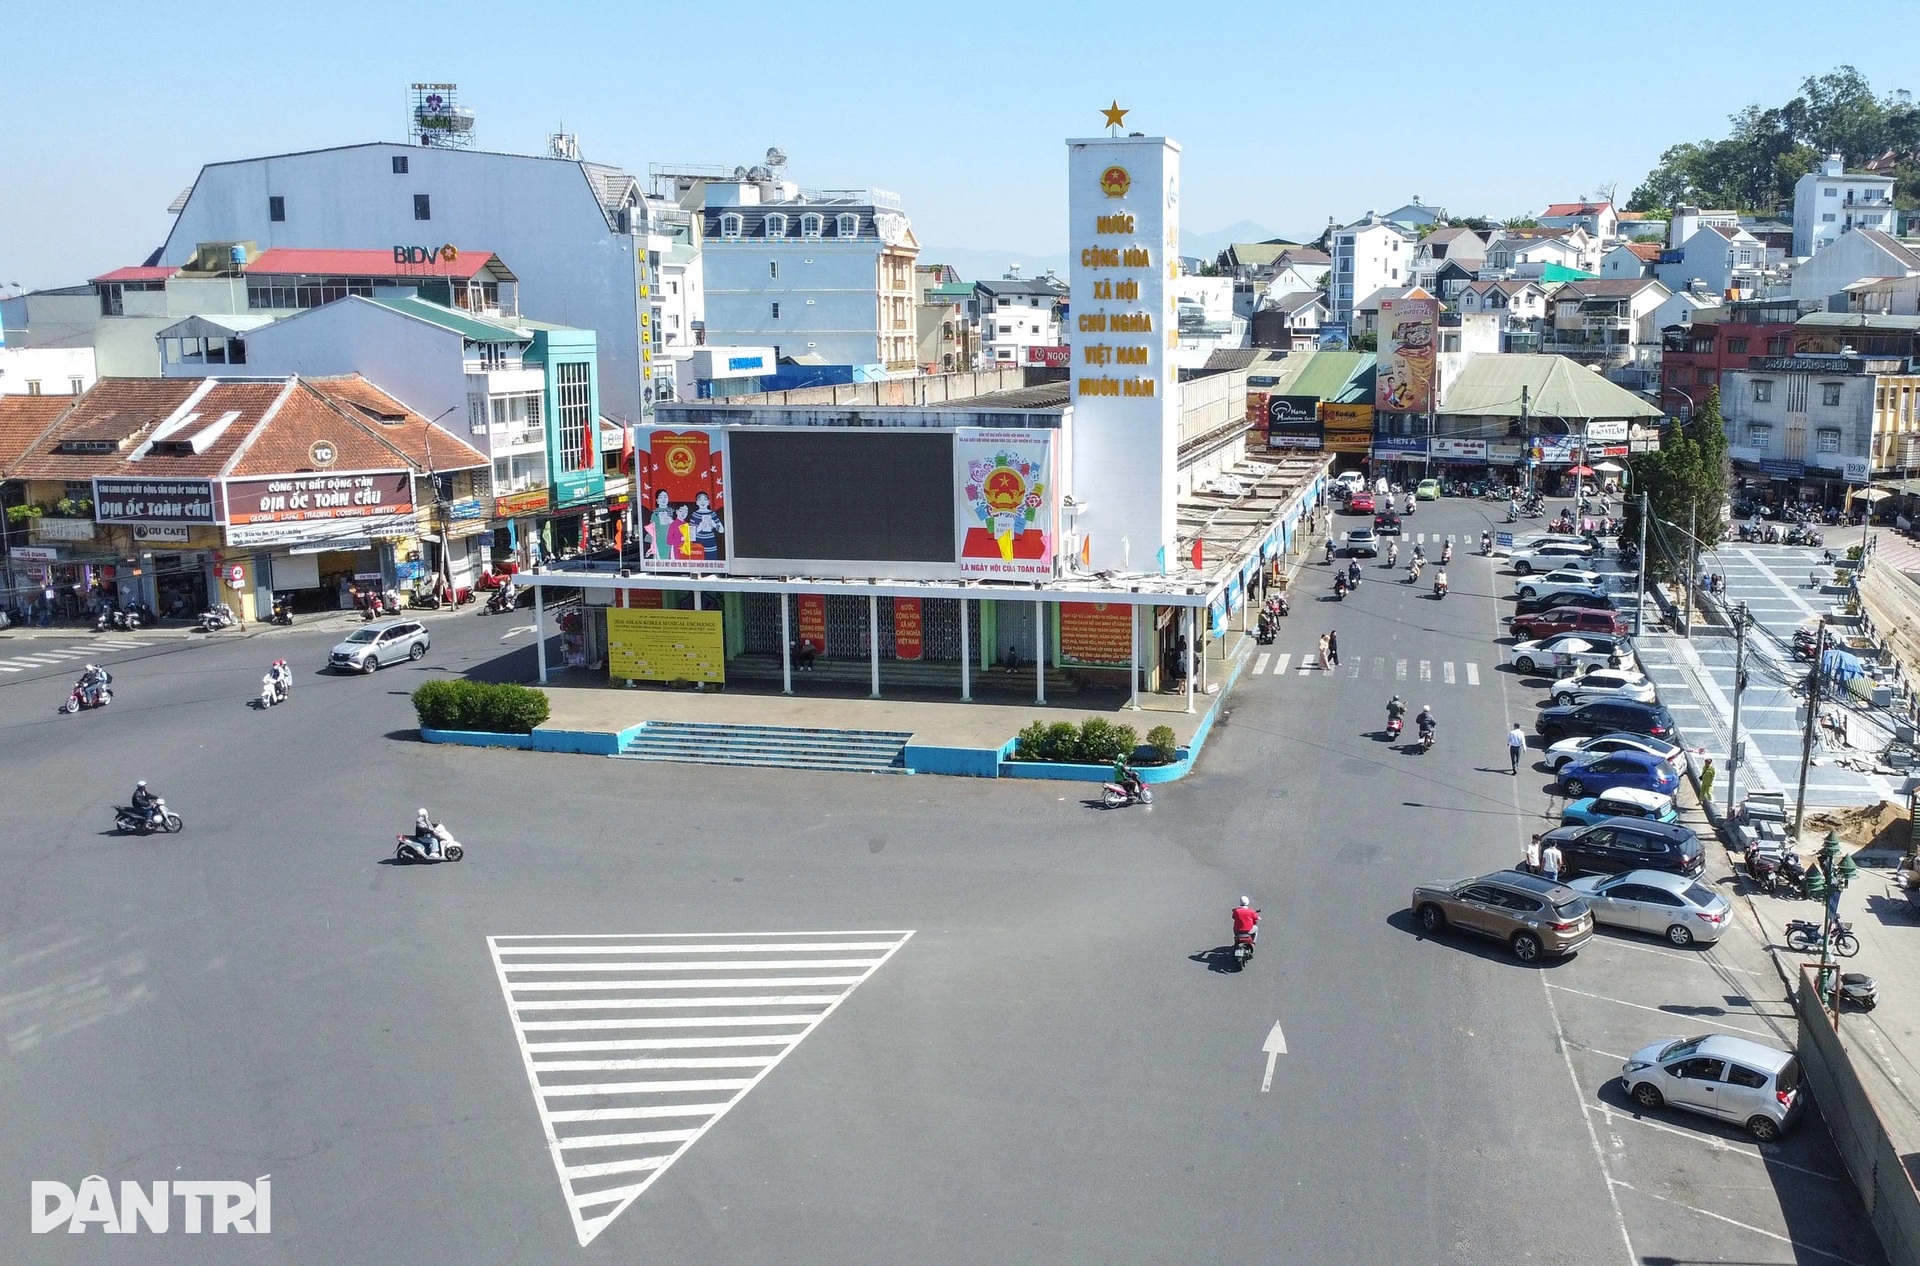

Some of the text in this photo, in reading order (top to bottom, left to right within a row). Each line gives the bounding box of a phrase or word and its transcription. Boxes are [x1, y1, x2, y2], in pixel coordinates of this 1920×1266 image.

[1096, 211, 1134, 234] NƯỚC
[394, 246, 440, 264] BIDV
[1082, 244, 1150, 270] CỘNG HÒA
[638, 248, 648, 299] KIM
[1094, 278, 1138, 304] XÃ HỘI
[1078, 307, 1152, 332] CHỦ NGHĨA
[641, 313, 652, 380] OANH
[1084, 342, 1148, 368] VIỆT NAM
[1078, 374, 1154, 397] MUÔN NĂM
[315, 449, 332, 460] TC
[268, 476, 374, 492] CÔNG TY BẤT ĐỘNG SẢN
[101, 498, 210, 517] ĐỊA ỐC TOÀN CẦU
[260, 487, 382, 513] ĐỊA ỐC TOÀN CẦU
[250, 514, 274, 522] GLOBAL
[304, 510, 332, 519] TRADING
[336, 508, 366, 517] COMPANY
[371, 506, 395, 514] LIMITED
[961, 562, 969, 571] LÀ
[971, 562, 988, 571] NGÀY
[990, 564, 1001, 573] HỘI
[1037, 564, 1050, 573] DÂN
